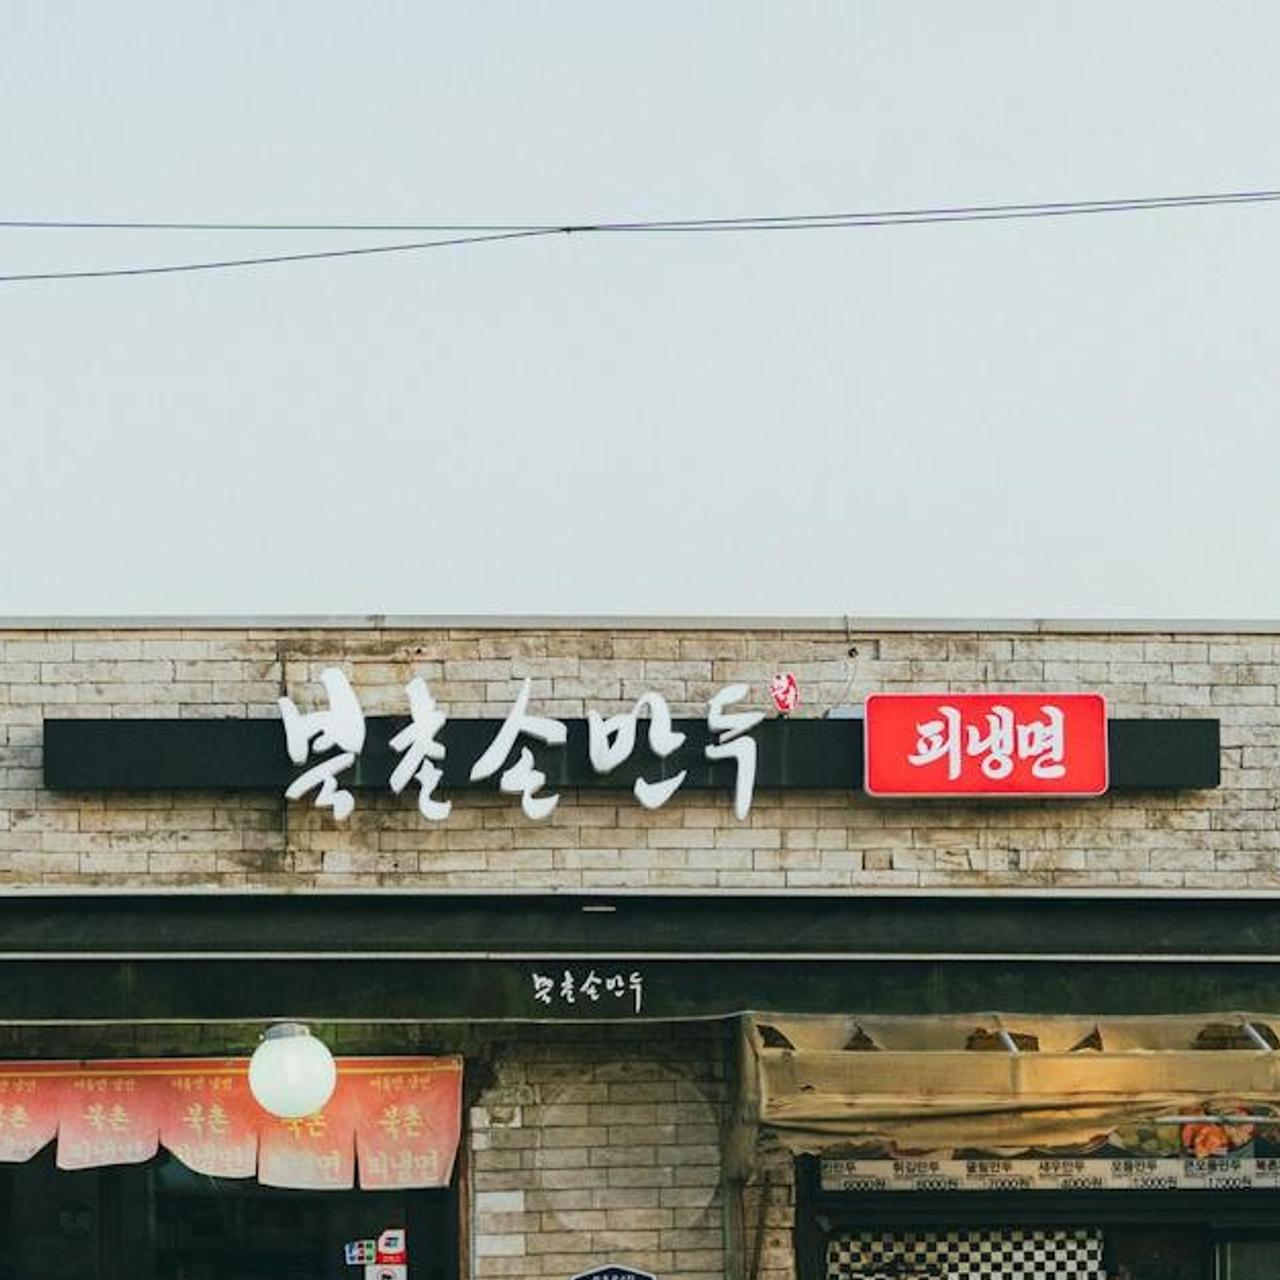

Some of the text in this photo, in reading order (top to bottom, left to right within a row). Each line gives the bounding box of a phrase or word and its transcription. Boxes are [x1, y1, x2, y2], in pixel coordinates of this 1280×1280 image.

[278, 667, 767, 822] 북촌손만두
[908, 705, 1067, 781] 피냉면
[532, 970, 643, 1013] 북촌손만두
